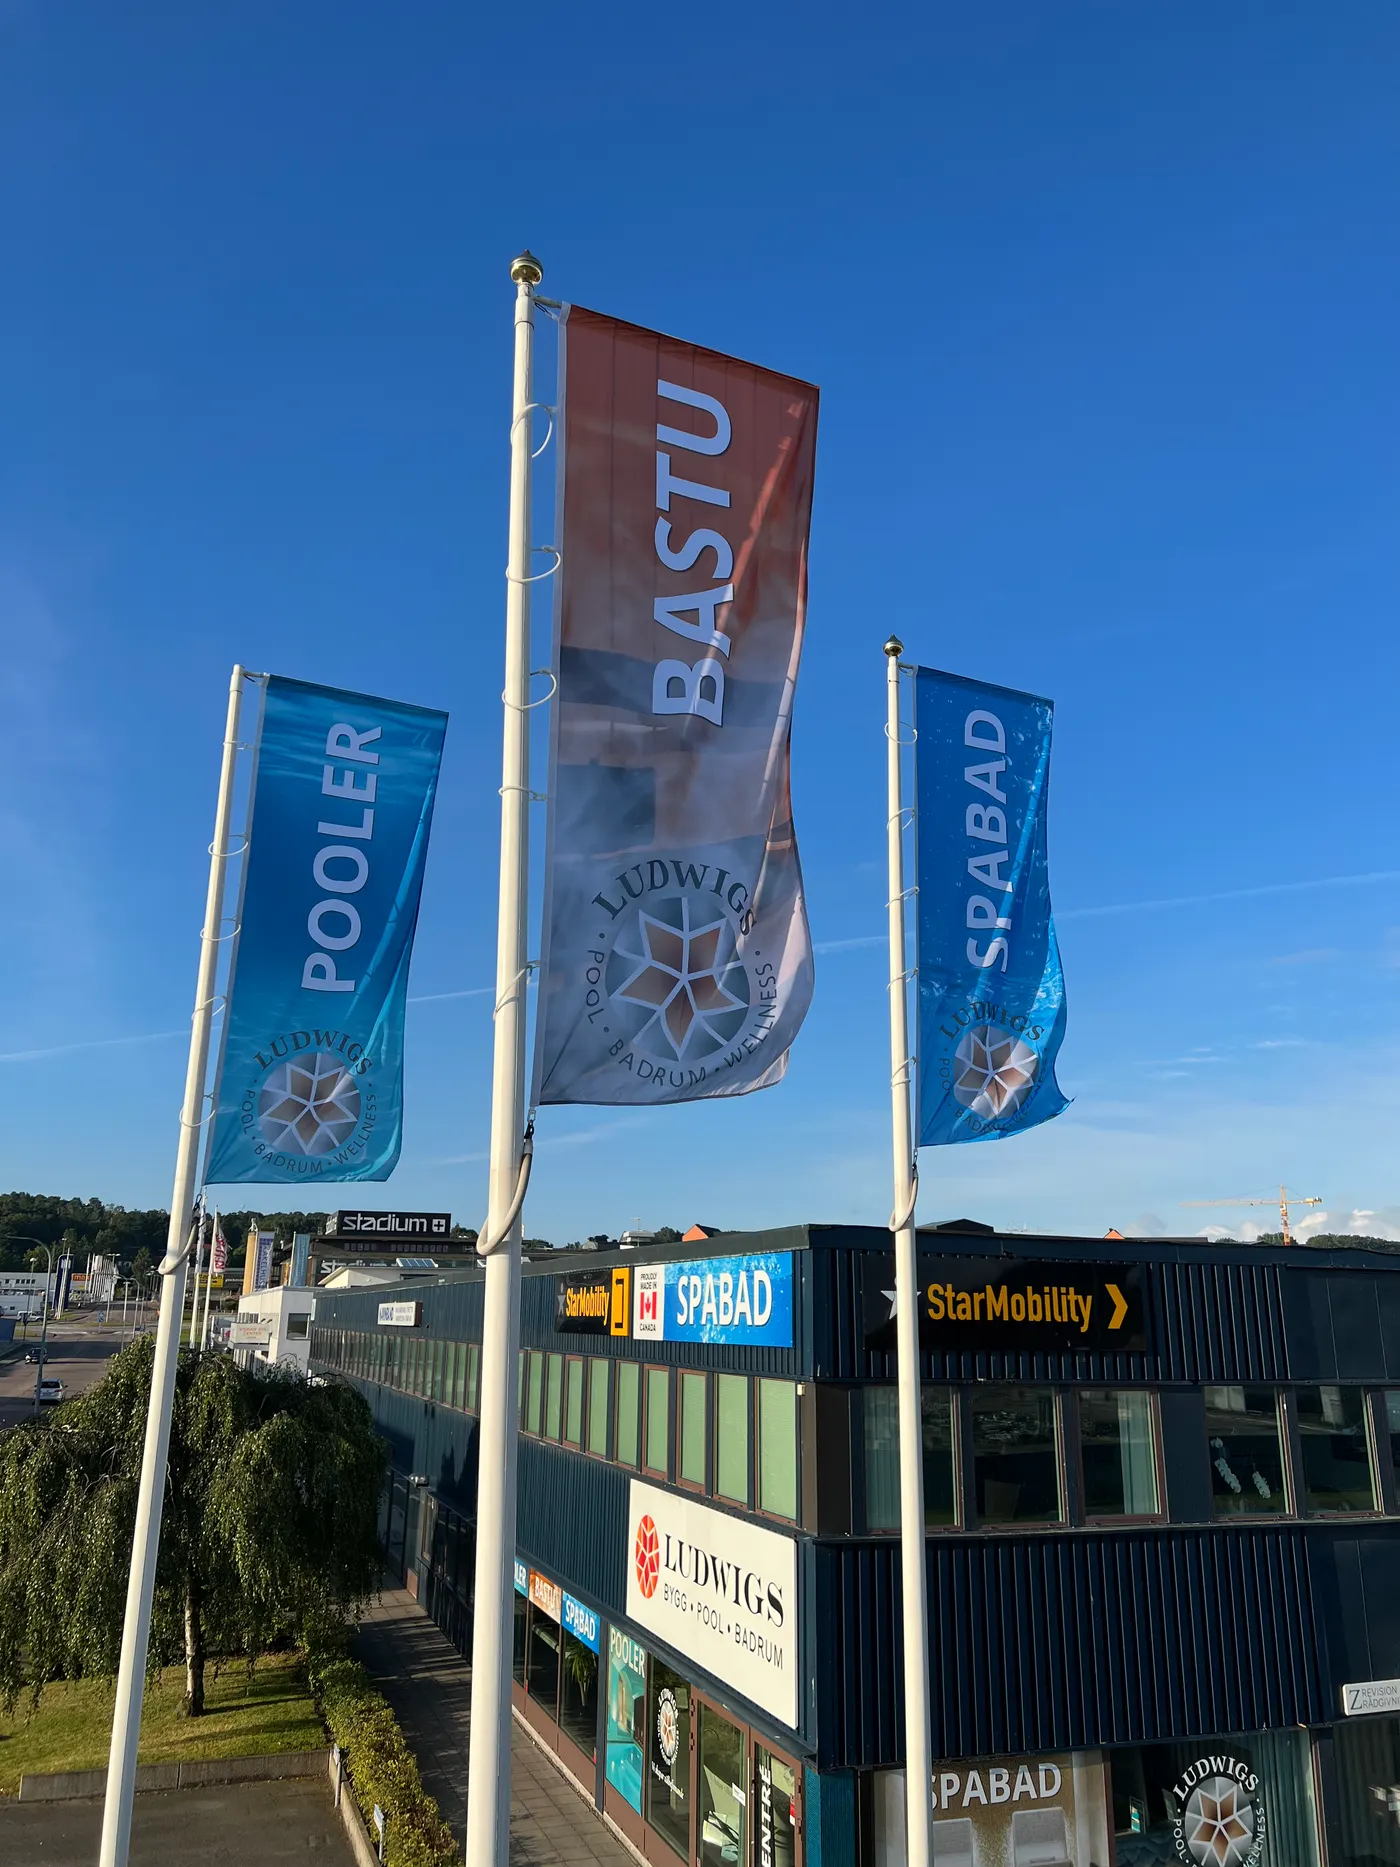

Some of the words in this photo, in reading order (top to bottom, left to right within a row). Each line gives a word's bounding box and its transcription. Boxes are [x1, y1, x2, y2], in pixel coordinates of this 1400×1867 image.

[652, 378, 735, 727] BASTU
[301, 722, 382, 992] POOLER
[964, 709, 1013, 973] SPABAD
[591, 859, 757, 936] LUDWIGS
[585, 949, 605, 1024] POOL
[723, 962, 777, 1068] WELLNESS
[939, 1001, 1045, 1040] LUDWIGS
[253, 1029, 373, 1076] LUDWIGS
[608, 1038, 706, 1088] BADRUM
[241, 1089, 256, 1135] POOL
[333, 1094, 377, 1165] WELLNESS
[254, 1143, 323, 1173] BADRUM
[342, 1213, 427, 1232] stadium
[565, 1285, 609, 1326] StarMobility
[640, 1281, 651, 1289] MADE
[652, 1281, 657, 1289] IN
[677, 1269, 772, 1327] SPABAD
[927, 1283, 1092, 1333] StarMobility
[514, 1561, 526, 1588] LER
[664, 1534, 784, 1628] LUDWIGS
[565, 1600, 595, 1641] SPABAD
[663, 1583, 687, 1612] BYGG
[697, 1602, 724, 1635] POOL
[735, 1623, 784, 1670] BADRUM
[610, 1627, 645, 1679] POOLER
[1349, 1689, 1362, 1710] Z
[1361, 1686, 1397, 1697] REVISION
[1173, 1755, 1259, 1801] LUDWIGS
[1173, 1819, 1187, 1860] POOL
